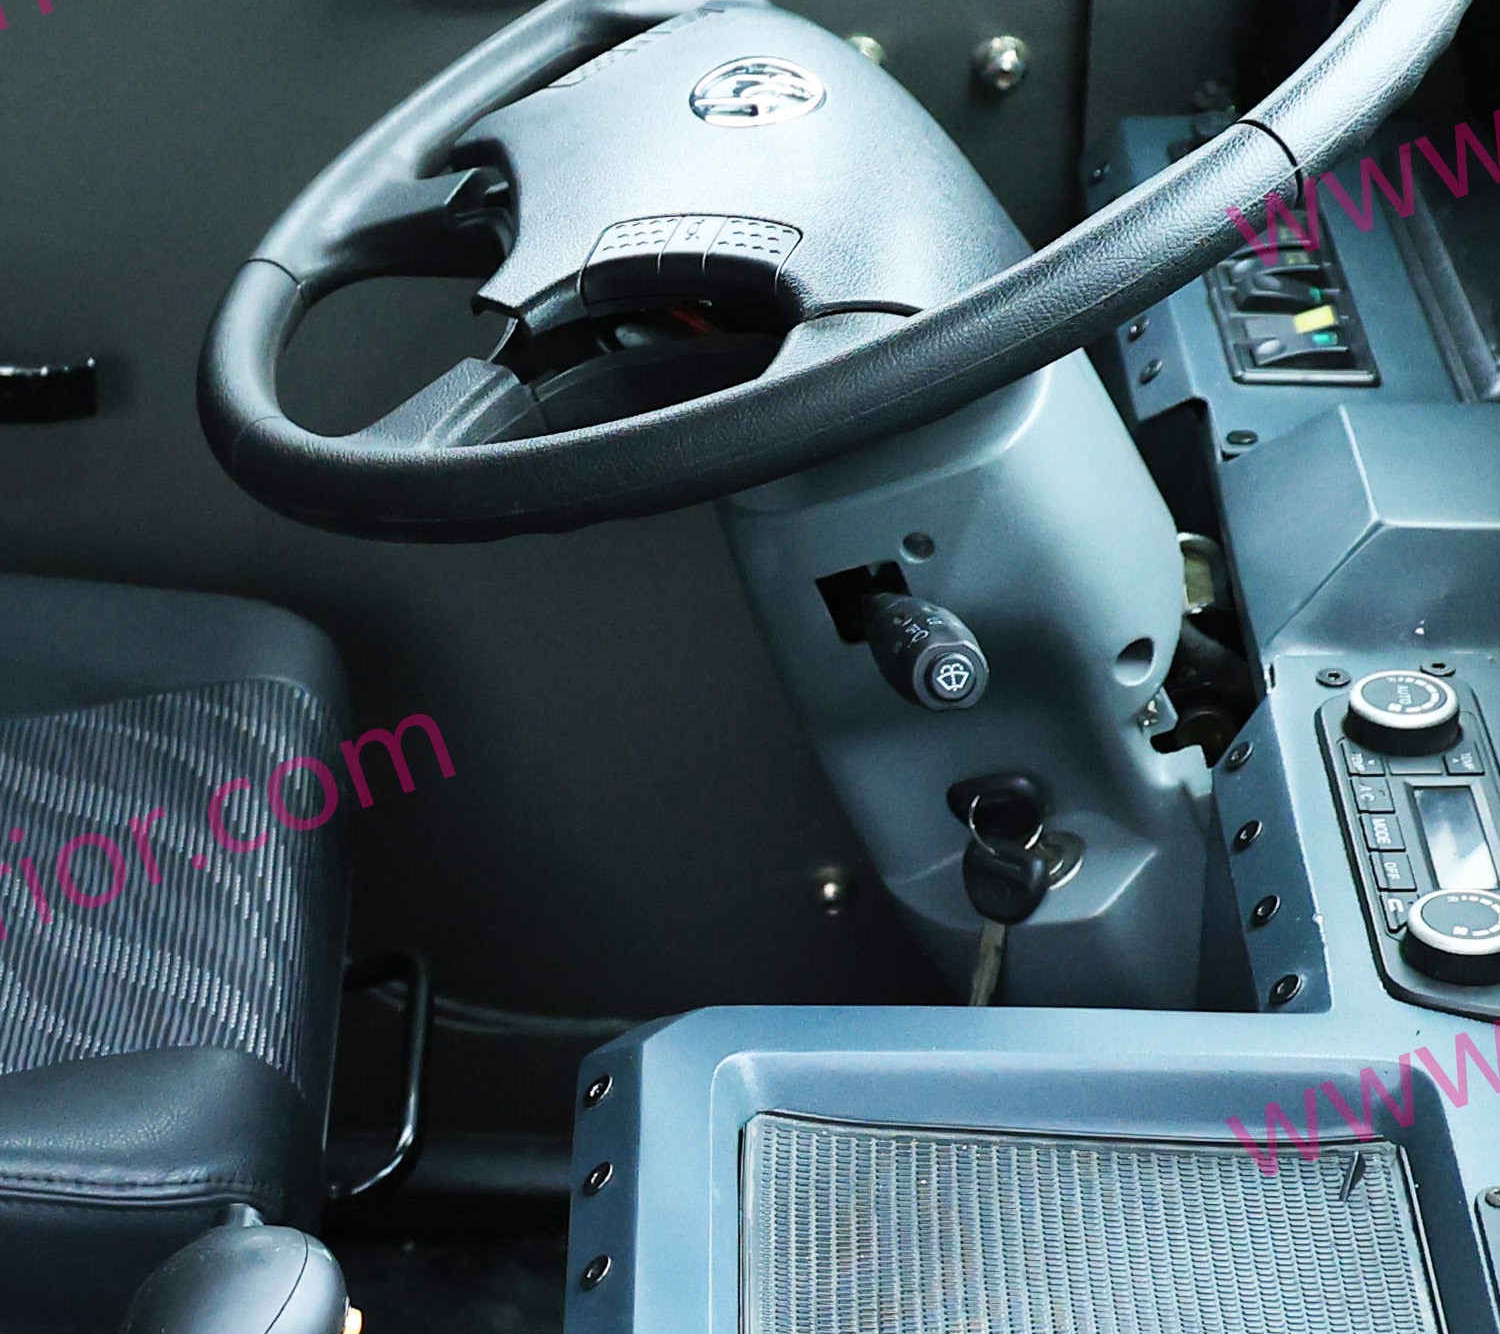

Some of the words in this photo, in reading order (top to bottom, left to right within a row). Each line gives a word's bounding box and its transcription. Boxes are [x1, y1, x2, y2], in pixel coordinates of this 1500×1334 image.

[1396, 685, 1413, 705] AUTO
[1372, 818, 1392, 844] MODE
[1383, 861, 1401, 880] OFF
